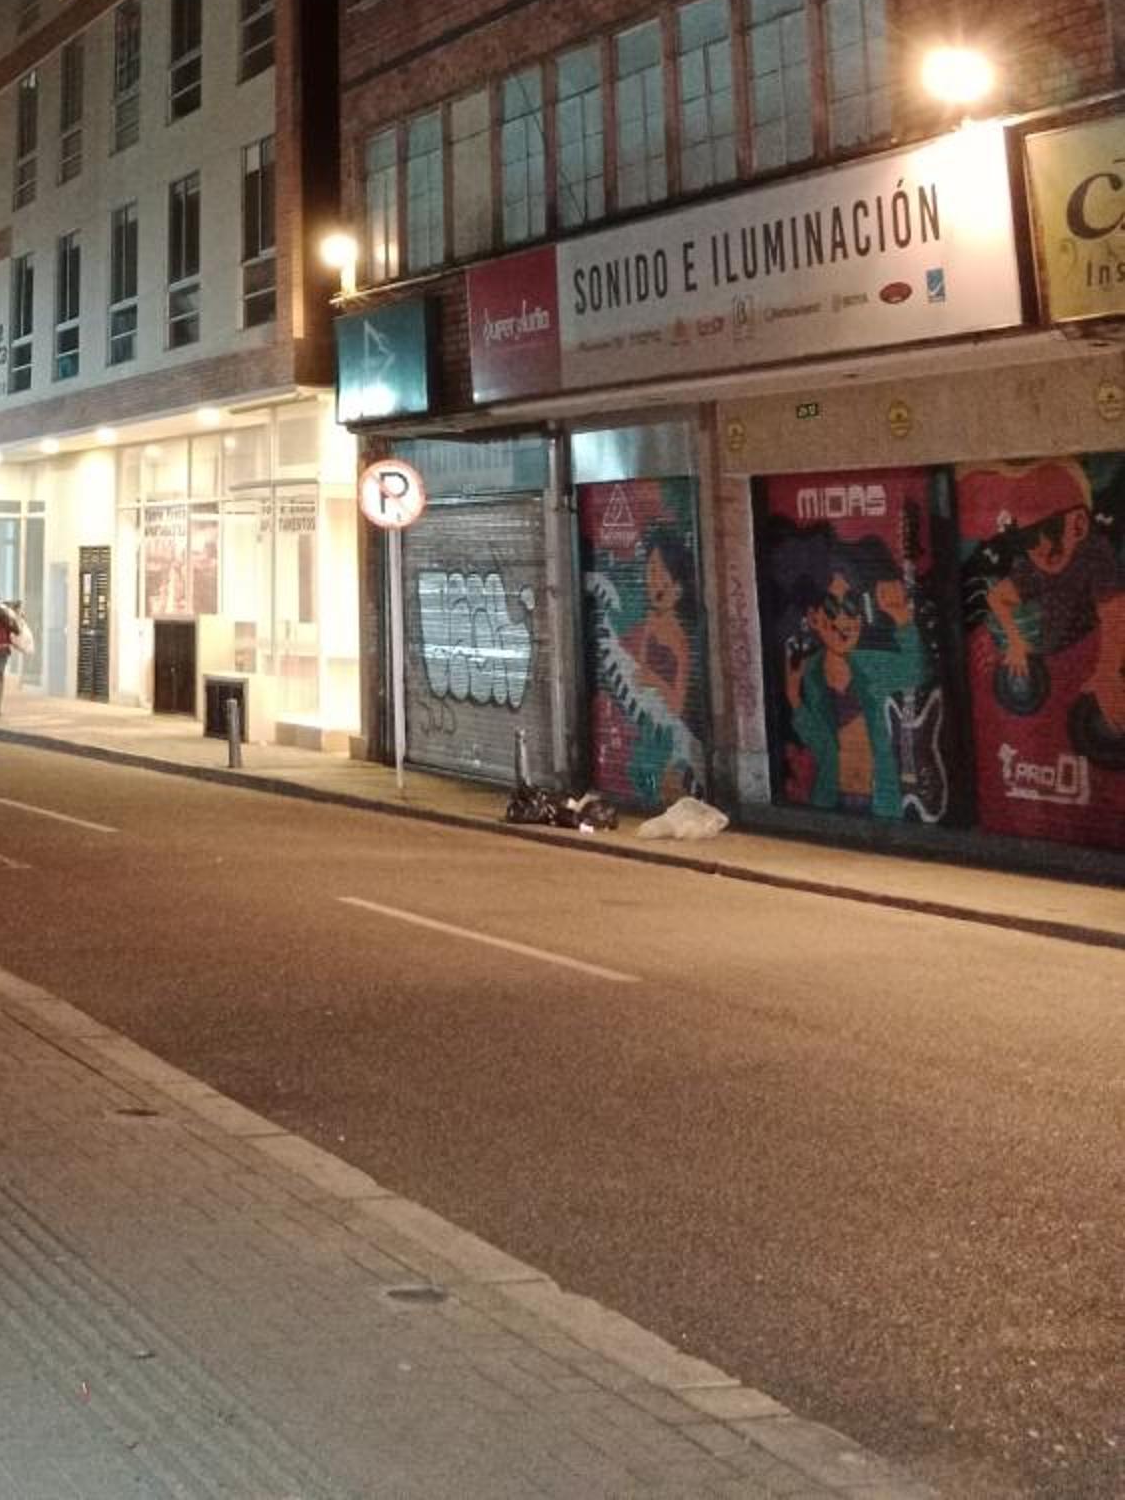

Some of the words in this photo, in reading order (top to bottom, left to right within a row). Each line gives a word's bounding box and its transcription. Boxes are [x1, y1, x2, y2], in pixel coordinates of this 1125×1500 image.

[573, 248, 668, 316] SONIDO
[682, 240, 698, 292] E
[711, 177, 940, 287] ILUMINACIÓN
[379, 471, 410, 514] P
